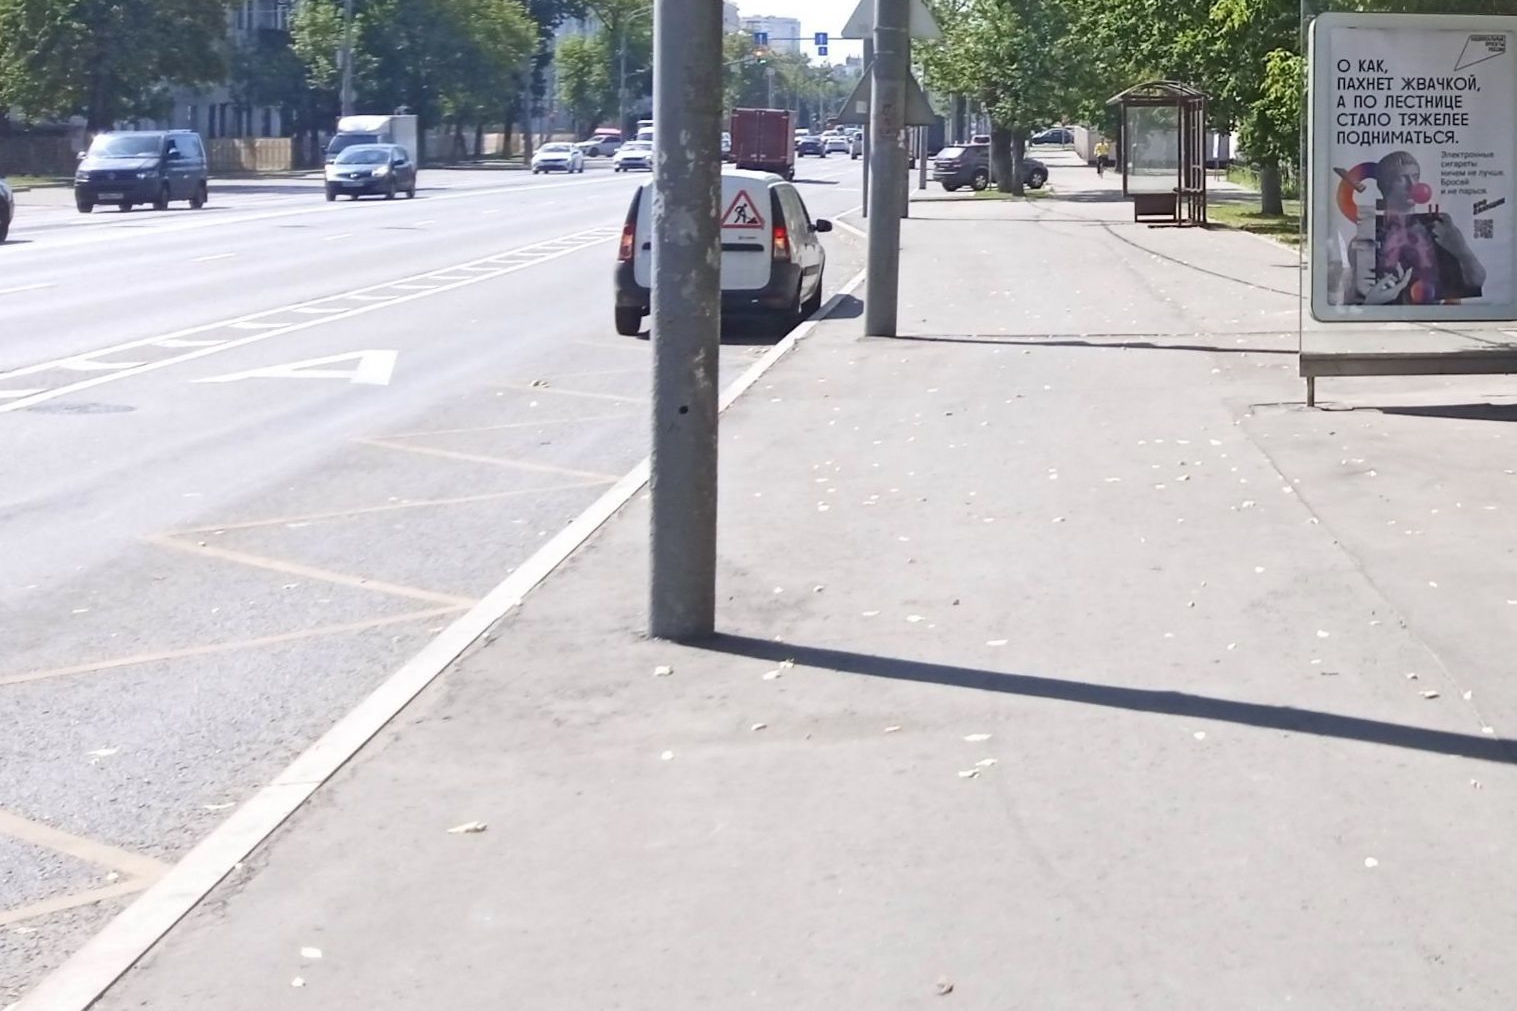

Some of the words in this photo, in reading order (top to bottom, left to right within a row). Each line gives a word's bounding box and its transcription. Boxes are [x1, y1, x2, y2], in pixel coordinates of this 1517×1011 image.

[1337, 59, 1350, 73] О
[1358, 59, 1388, 74] КАК,
[1337, 77, 1394, 91] ПАХНЕТ
[1401, 74, 1481, 92] ЖВАЧКОЙ,
[1337, 95, 1346, 108] А
[1354, 95, 1377, 109] ПО
[1384, 95, 1462, 111] ЛЕСТНИЦЕ
[1337, 113, 1391, 127] СТАЛО
[1400, 113, 1469, 127] ТЯЖЕЛЕЕ
[1337, 130, 1459, 146] ПОДНИМАТЬСЯ.
